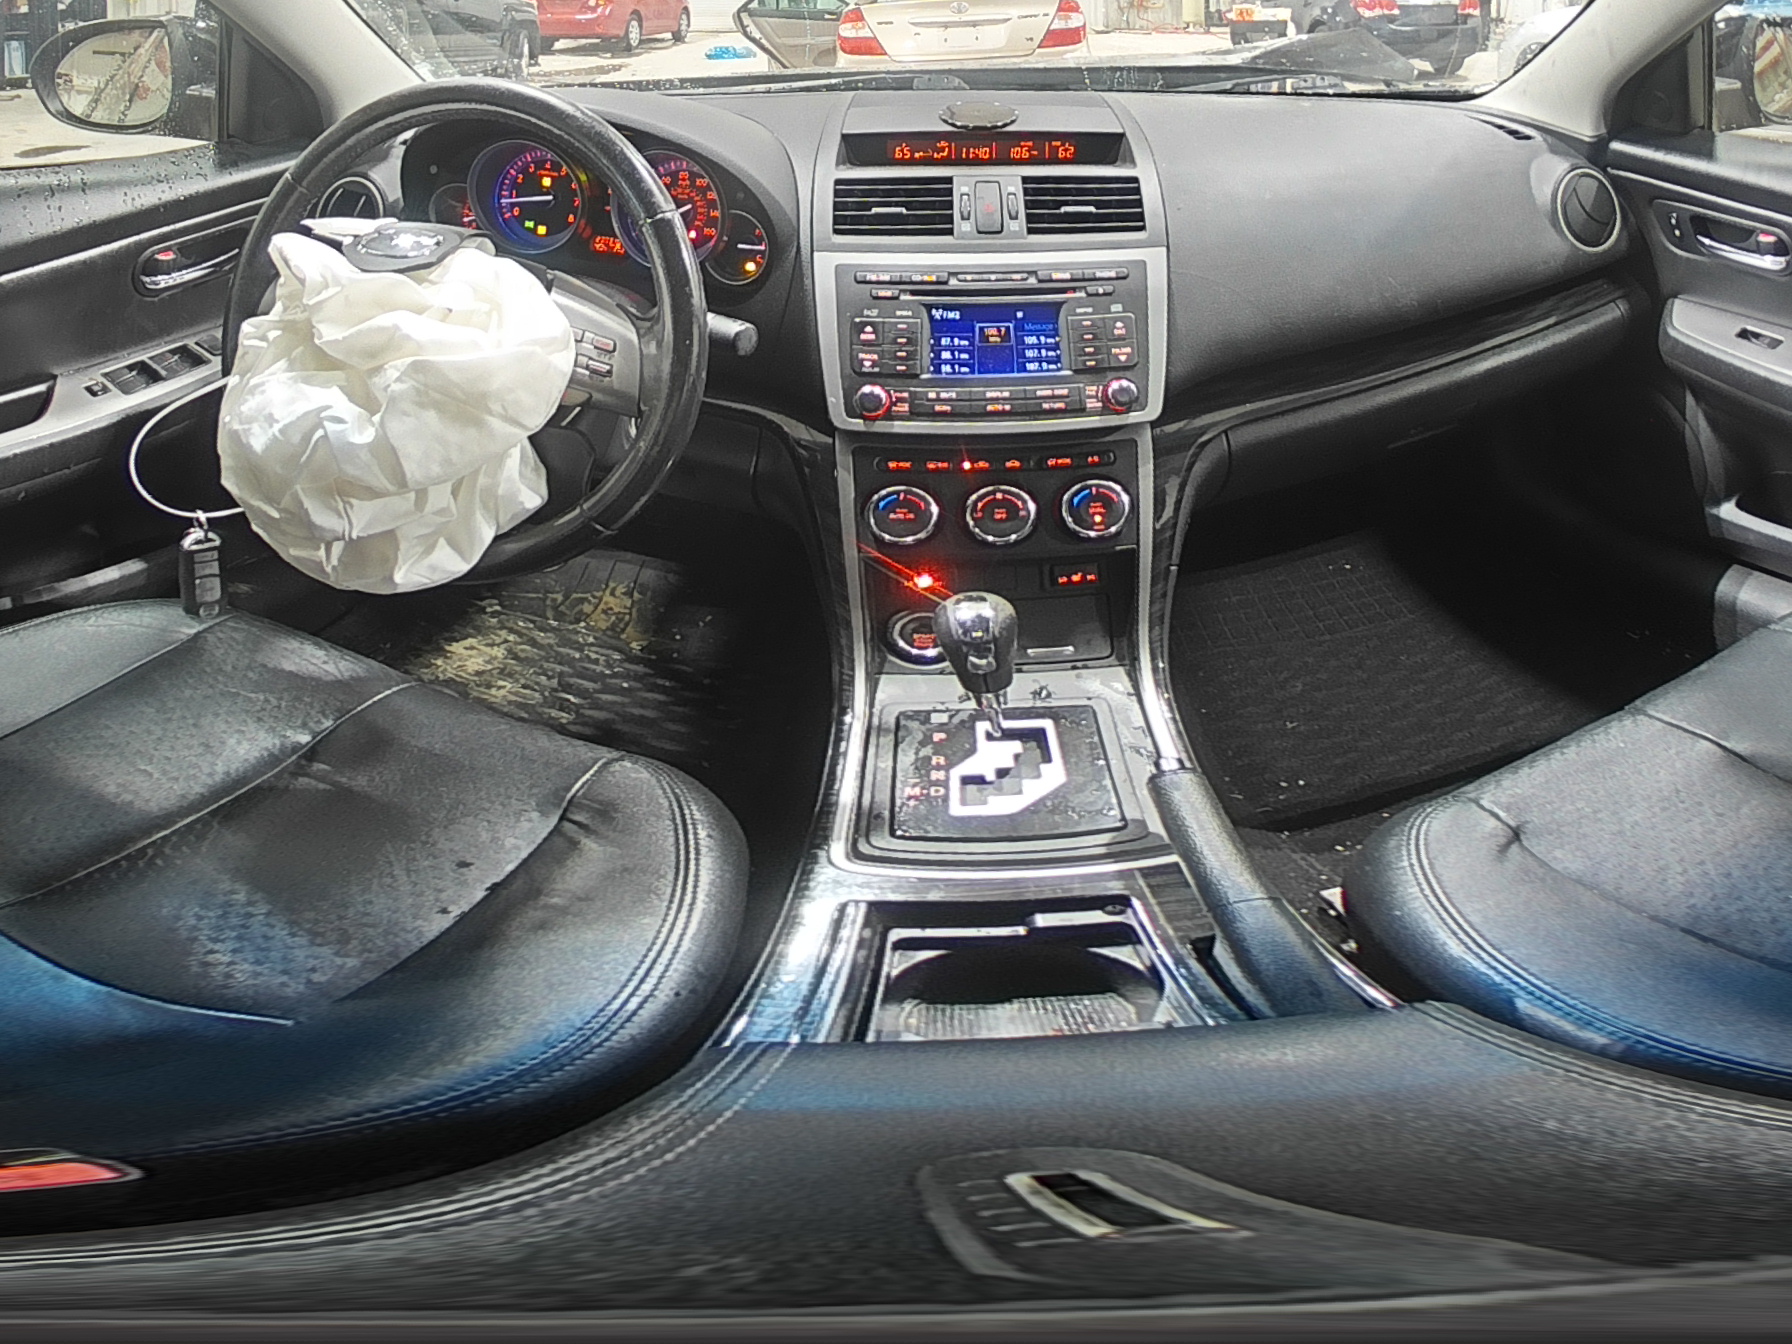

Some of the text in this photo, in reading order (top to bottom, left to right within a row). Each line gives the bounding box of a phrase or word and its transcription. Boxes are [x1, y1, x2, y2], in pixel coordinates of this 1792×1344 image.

[529, 163, 535, 173] 3
[517, 173, 524, 184] 2
[573, 196, 581, 207] 7
[513, 206, 520, 217] 0
[567, 213, 575, 223] 8
[932, 731, 948, 743] P
[931, 755, 947, 766] R
[929, 769, 946, 781] N
[904, 786, 946, 797] M D
